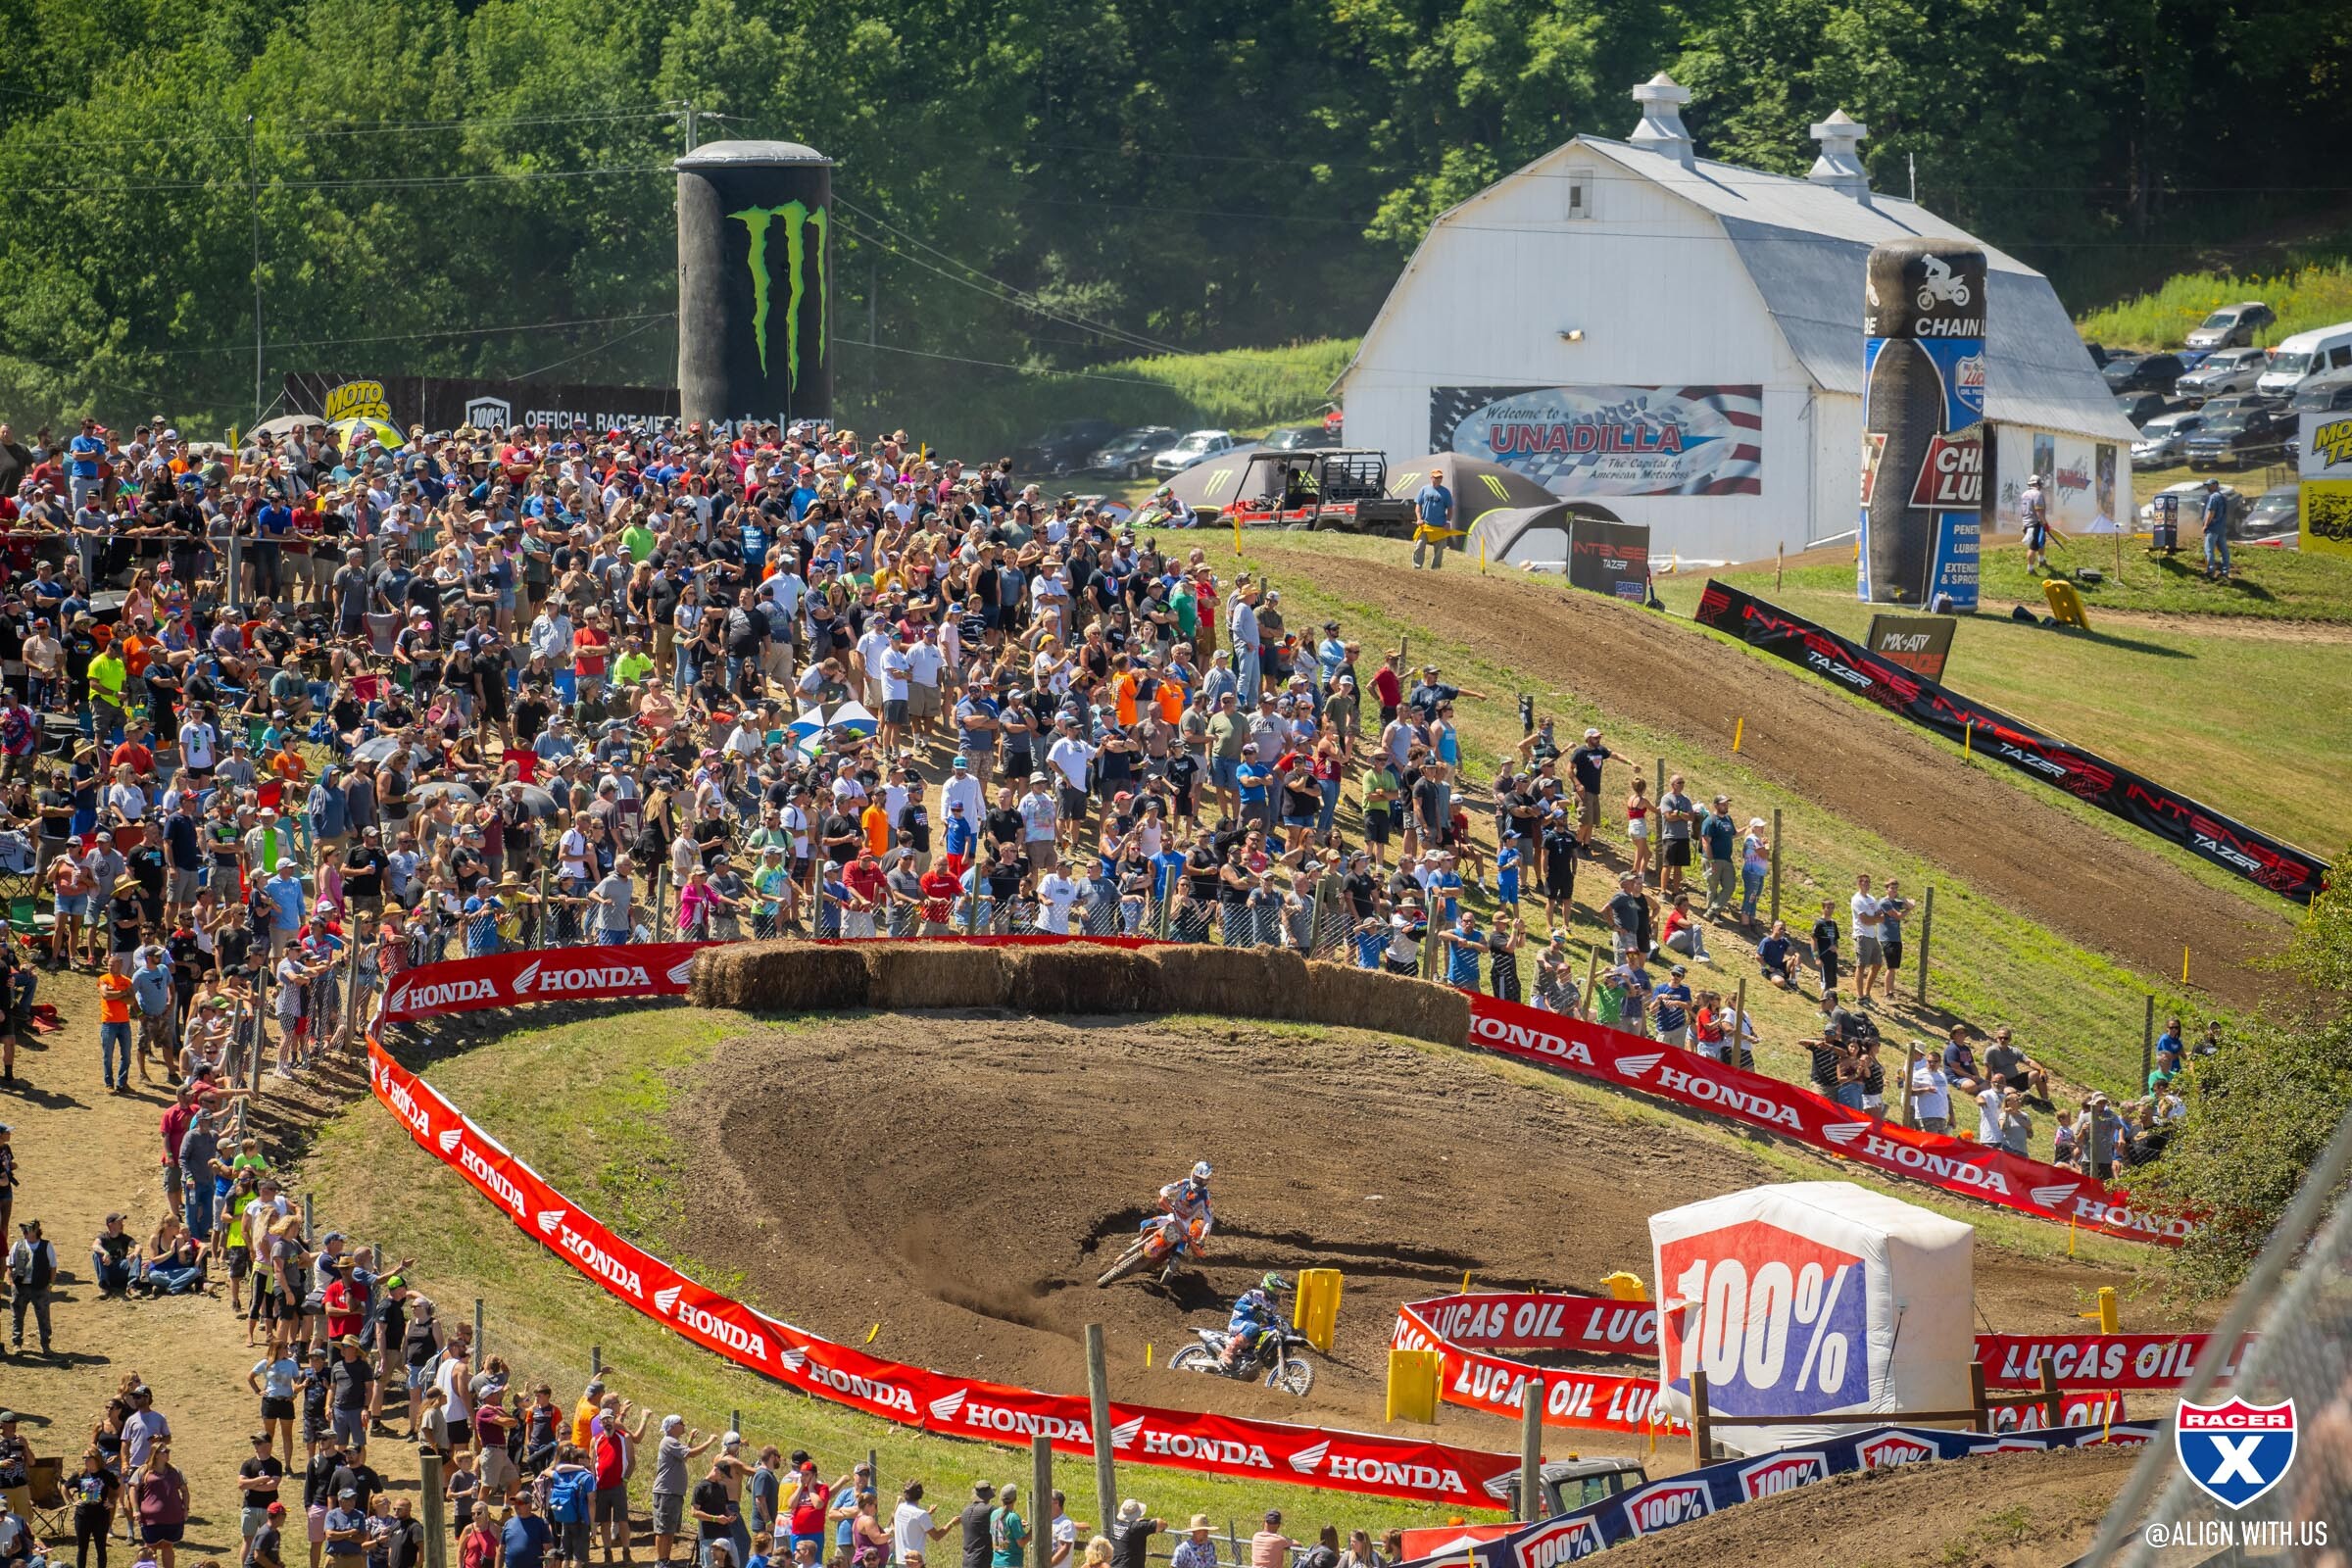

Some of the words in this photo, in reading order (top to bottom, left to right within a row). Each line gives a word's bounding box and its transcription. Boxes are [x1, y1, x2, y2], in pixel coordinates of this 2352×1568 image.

[1915, 317, 1980, 336] CHAIN
[326, 381, 383, 418] MOTO
[333, 403, 390, 422] TEES
[471, 407, 506, 429] 100%
[1486, 406, 1540, 419] Welcome
[1546, 406, 1560, 419] to
[596, 413, 637, 431] RACE
[1489, 422, 1684, 454] UNADILLA
[1589, 469, 1637, 480] American
[1630, 457, 1669, 470] Capital
[1671, 457, 1683, 470] of
[1573, 541, 1646, 560] INTENSE
[1602, 558, 1628, 571] TAZER
[1741, 605, 1922, 703] INTENSE
[1808, 651, 1873, 689] TAZER
[1932, 695, 2116, 789] INTENSE
[1999, 743, 2067, 778] TAZER
[2126, 783, 2311, 882] INTENSE
[2192, 833, 2262, 871] TAZER
[411, 978, 499, 1010] HONDA
[539, 966, 652, 993] HONDA
[1656, 1065, 1804, 1131] HONDA
[1862, 1134, 2011, 1196] HONDA
[2072, 1196, 2205, 1238] HOND
[460, 1143, 527, 1218] HONDA
[560, 1223, 644, 1300] HONDA
[677, 1299, 767, 1361] HONDA
[808, 1359, 918, 1414] HONDA
[965, 1402, 1094, 1445] HONDA
[1143, 1430, 1274, 1469] HONDA
[1329, 1454, 1468, 1494] HONDA
[1433, 1301, 1507, 1341] LUCAS
[1513, 1301, 1565, 1339] OIL
[1677, 1258, 1849, 1395] 100%
[2000, 1343, 2127, 1380] LUCAS
[2134, 1343, 2195, 1379] OIL
[1454, 1359, 1544, 1411] LUCA
[1547, 1380, 1594, 1418] OIL
[1529, 1525, 1592, 1568] 100%
[1639, 1490, 1702, 1533] 100%
[1753, 1462, 1818, 1495] 100%
